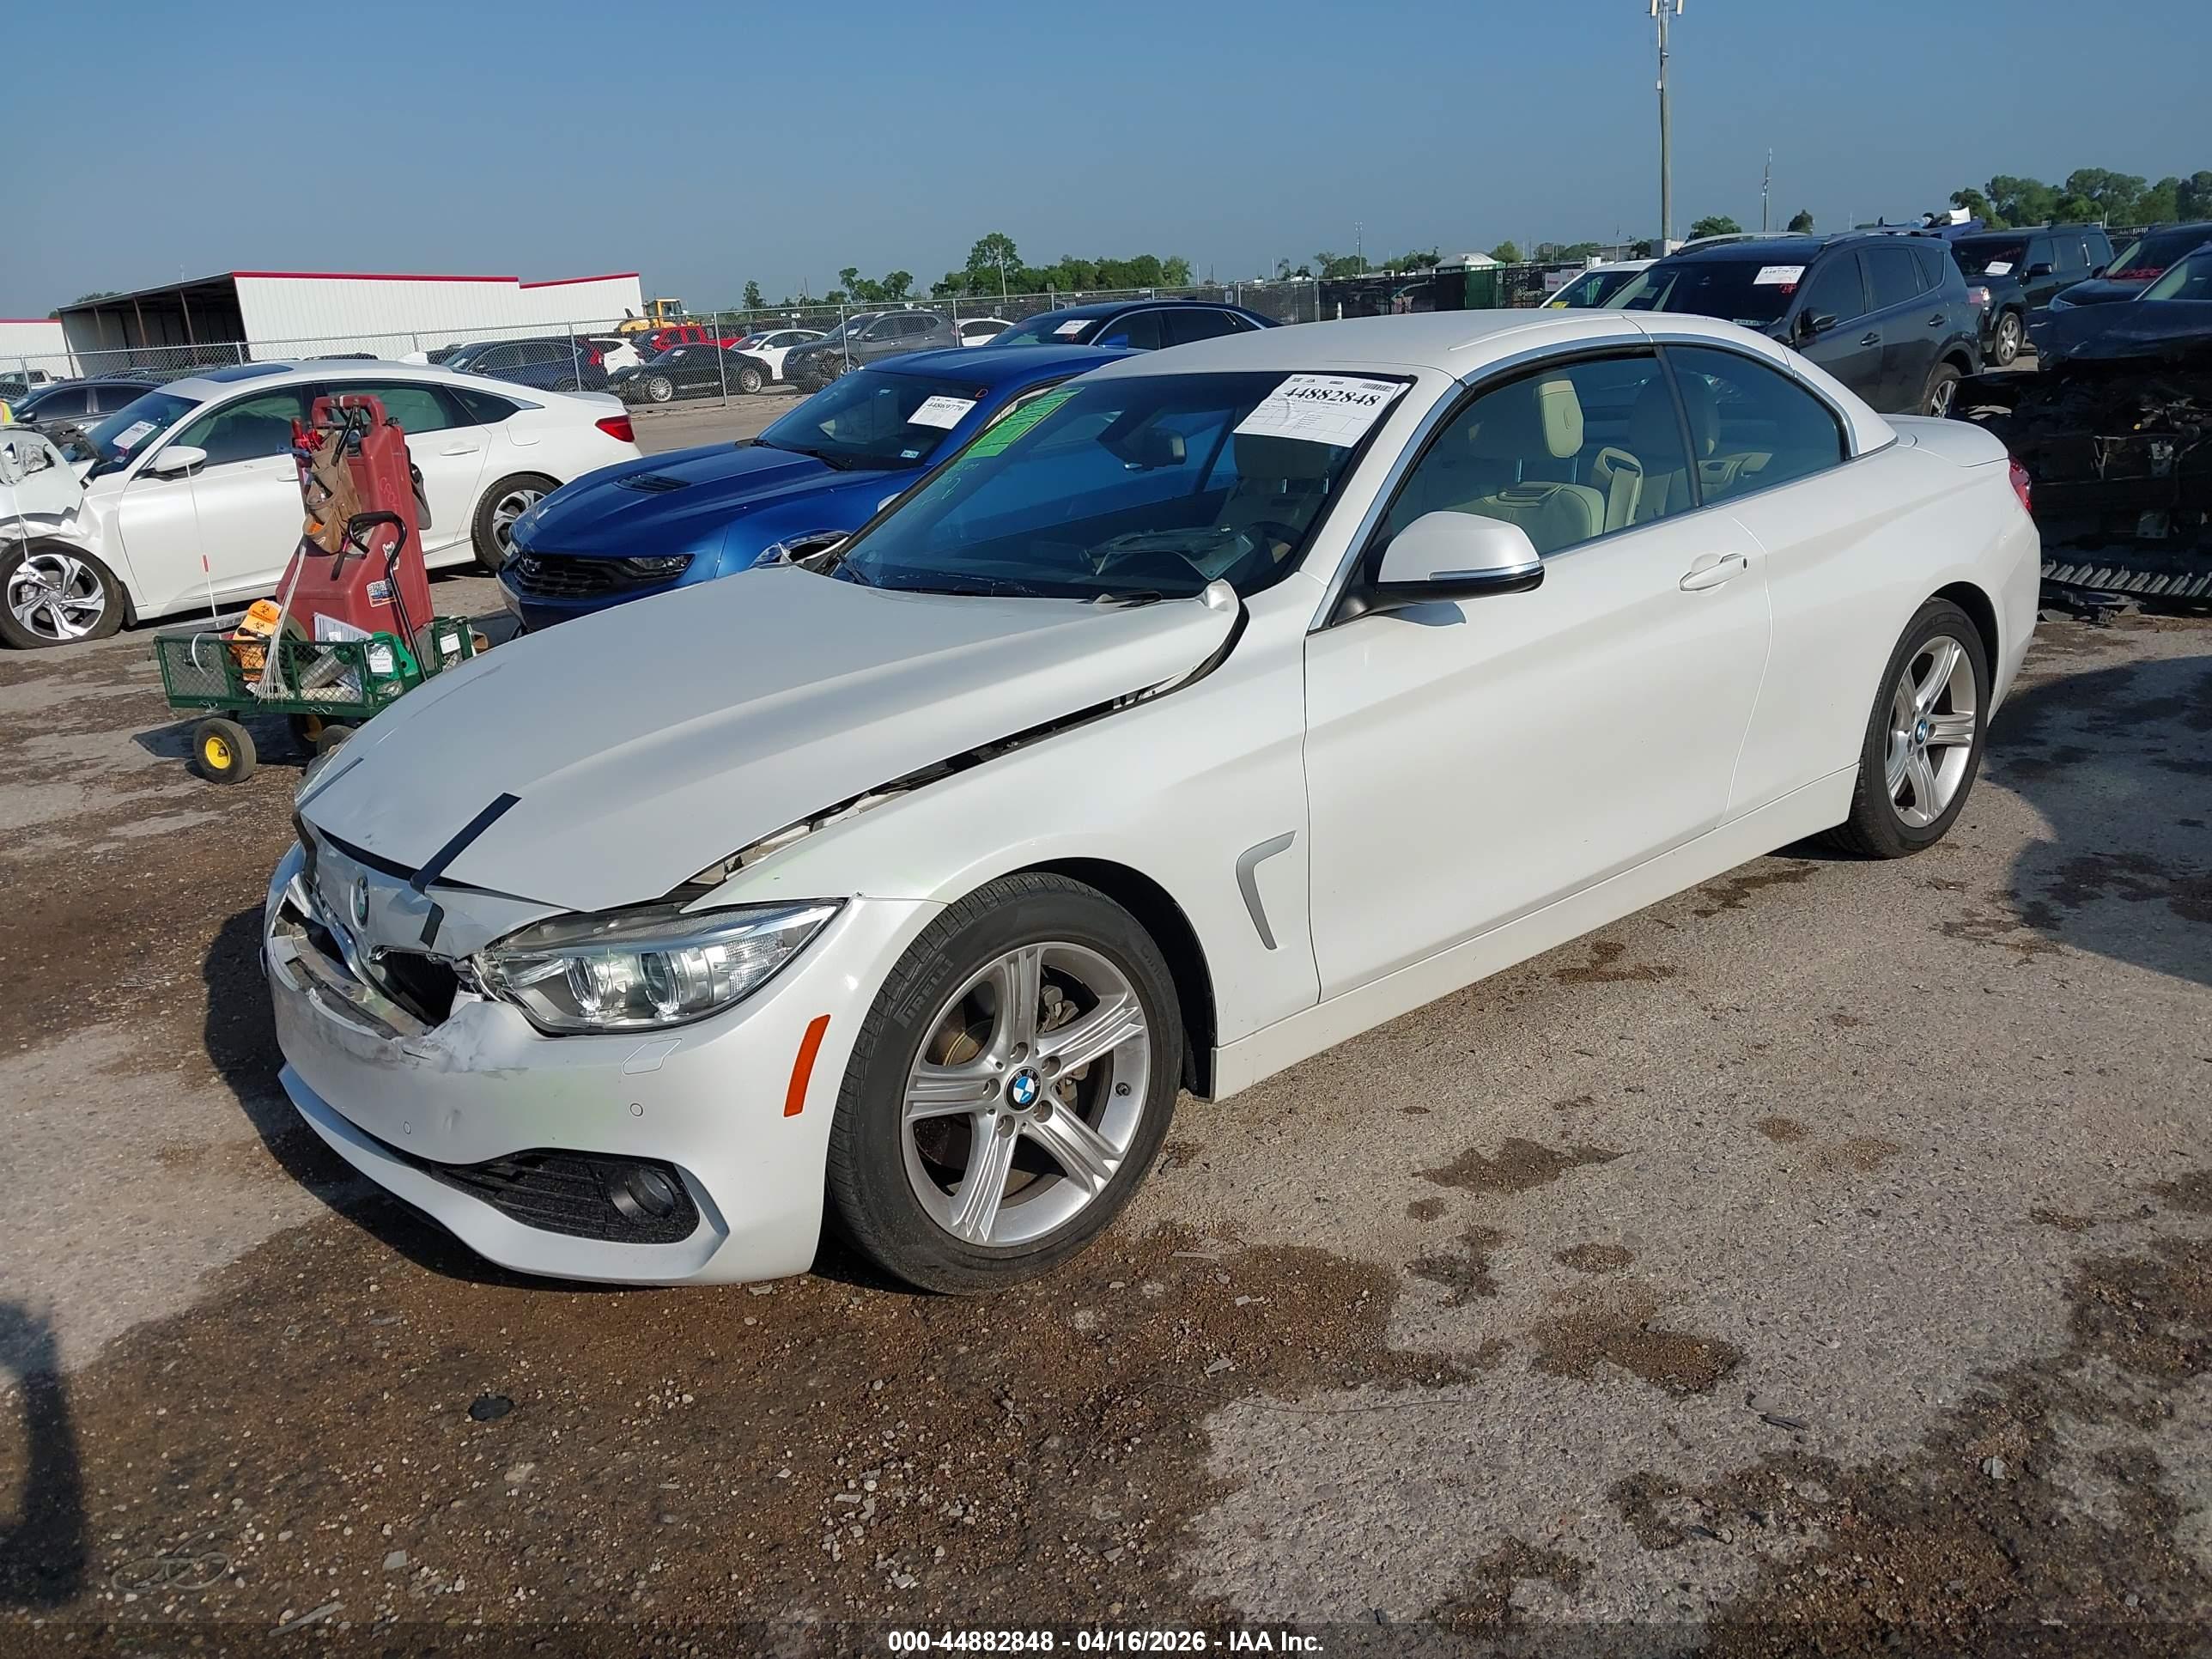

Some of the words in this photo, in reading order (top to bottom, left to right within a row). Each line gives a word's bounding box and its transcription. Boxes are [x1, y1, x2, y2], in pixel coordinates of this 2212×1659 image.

[1284, 386, 1382, 406] 44882848
[893, 953, 954, 1029] PIRELLI
[1015, 1069, 1042, 1087] BMW
